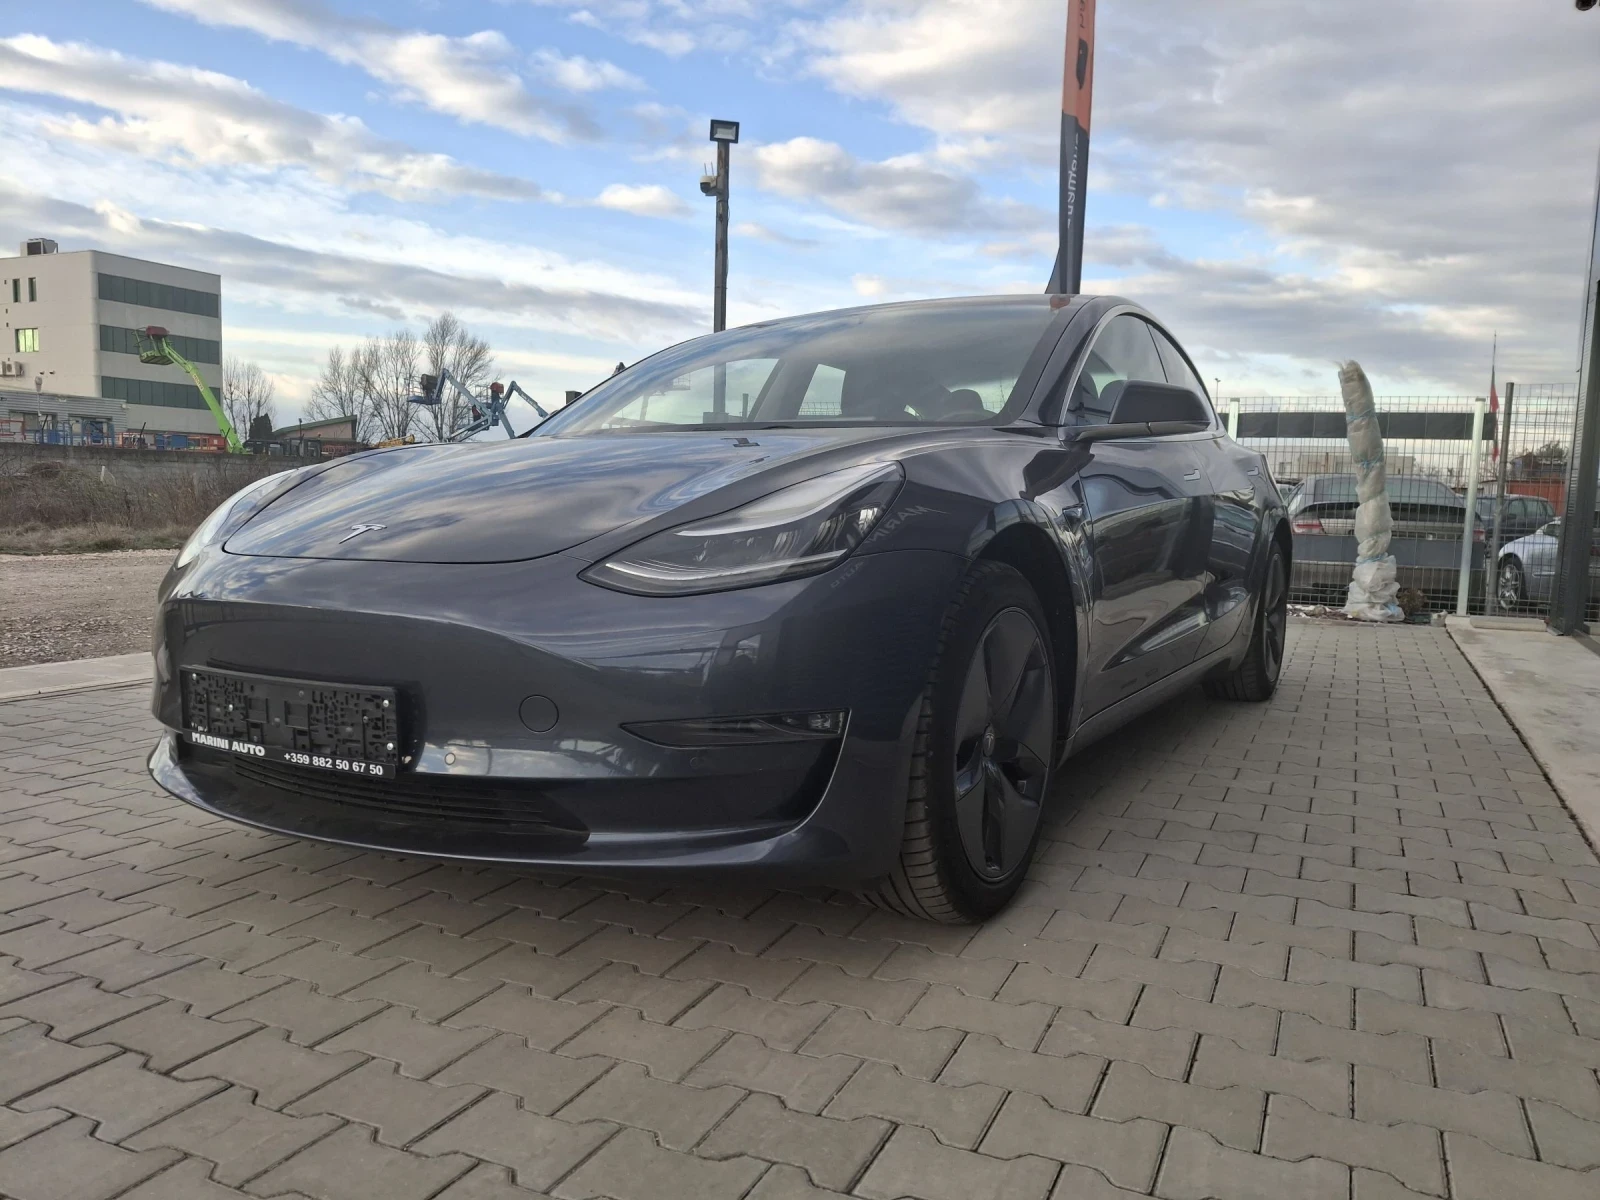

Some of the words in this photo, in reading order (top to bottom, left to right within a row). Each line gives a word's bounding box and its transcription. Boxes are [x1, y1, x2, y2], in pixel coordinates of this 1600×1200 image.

[191, 732, 230, 749] MARINI
[231, 741, 265, 757] AUTO
[283, 752, 310, 765] +359
[312, 756, 333, 768] 882
[335, 759, 350, 771] 50
[352, 762, 366, 773] 67
[369, 764, 384, 776] 50
